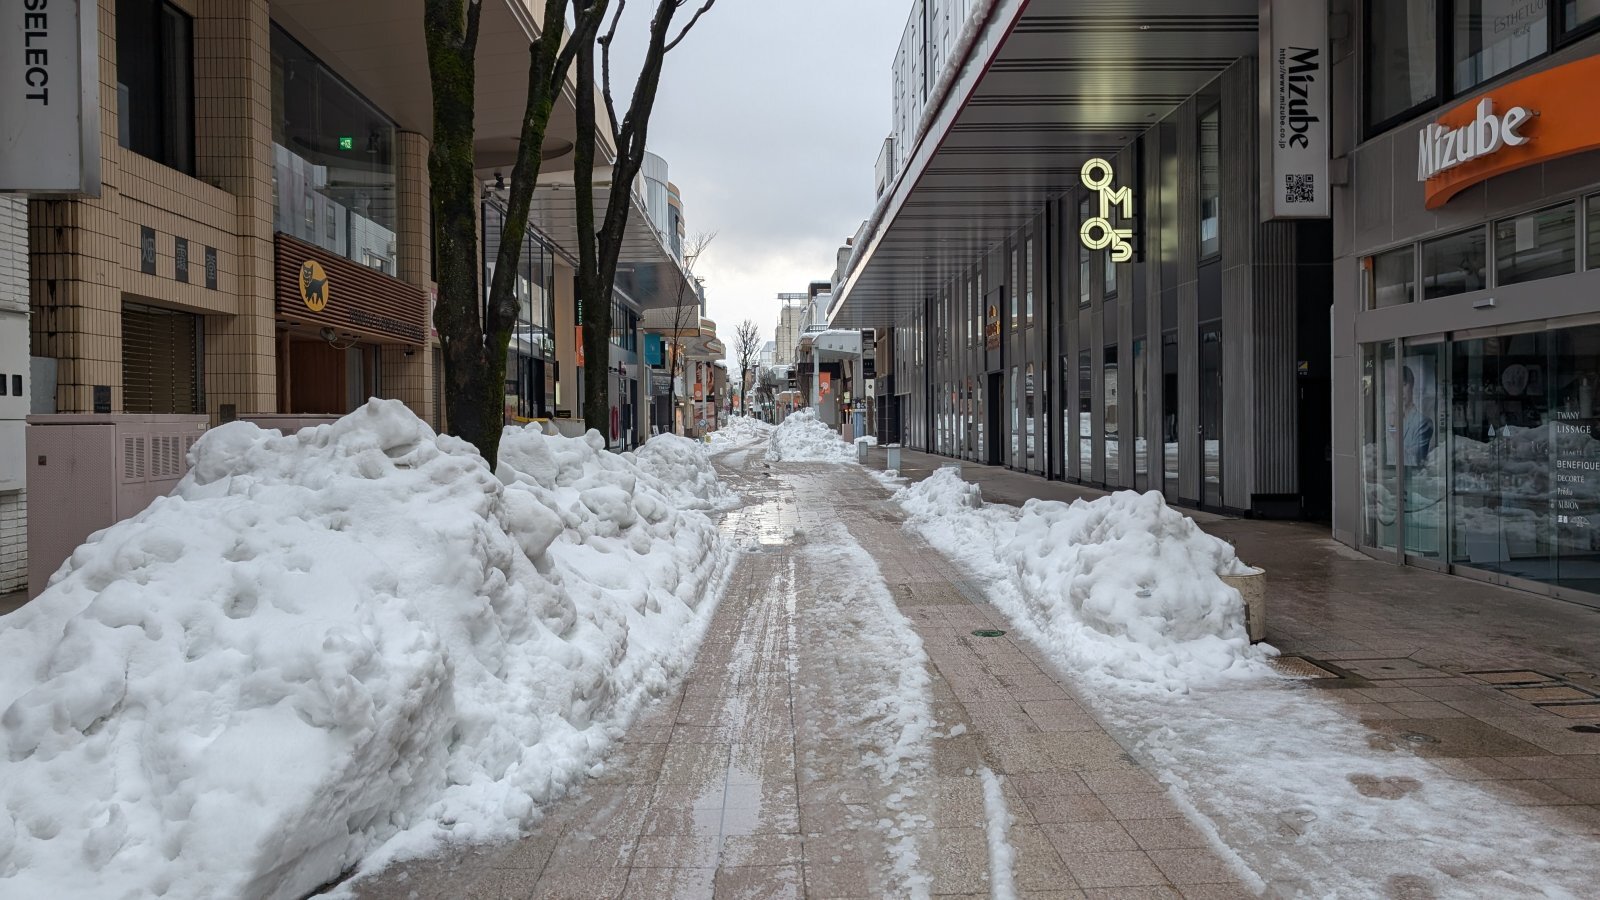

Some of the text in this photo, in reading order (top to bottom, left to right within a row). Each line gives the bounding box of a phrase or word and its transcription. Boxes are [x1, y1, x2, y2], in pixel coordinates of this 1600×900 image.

[24, 0, 49, 106] SELECT
[1278, 48, 1287, 149] http://www.mizube.co.jp
[1288, 46, 1320, 150] Mizube
[1417, 97, 1532, 182] Mizube
[1557, 411, 1580, 420] TWANY
[1557, 425, 1592, 434] LISSAGE
[1556, 459, 1600, 470] BENEFIQUE
